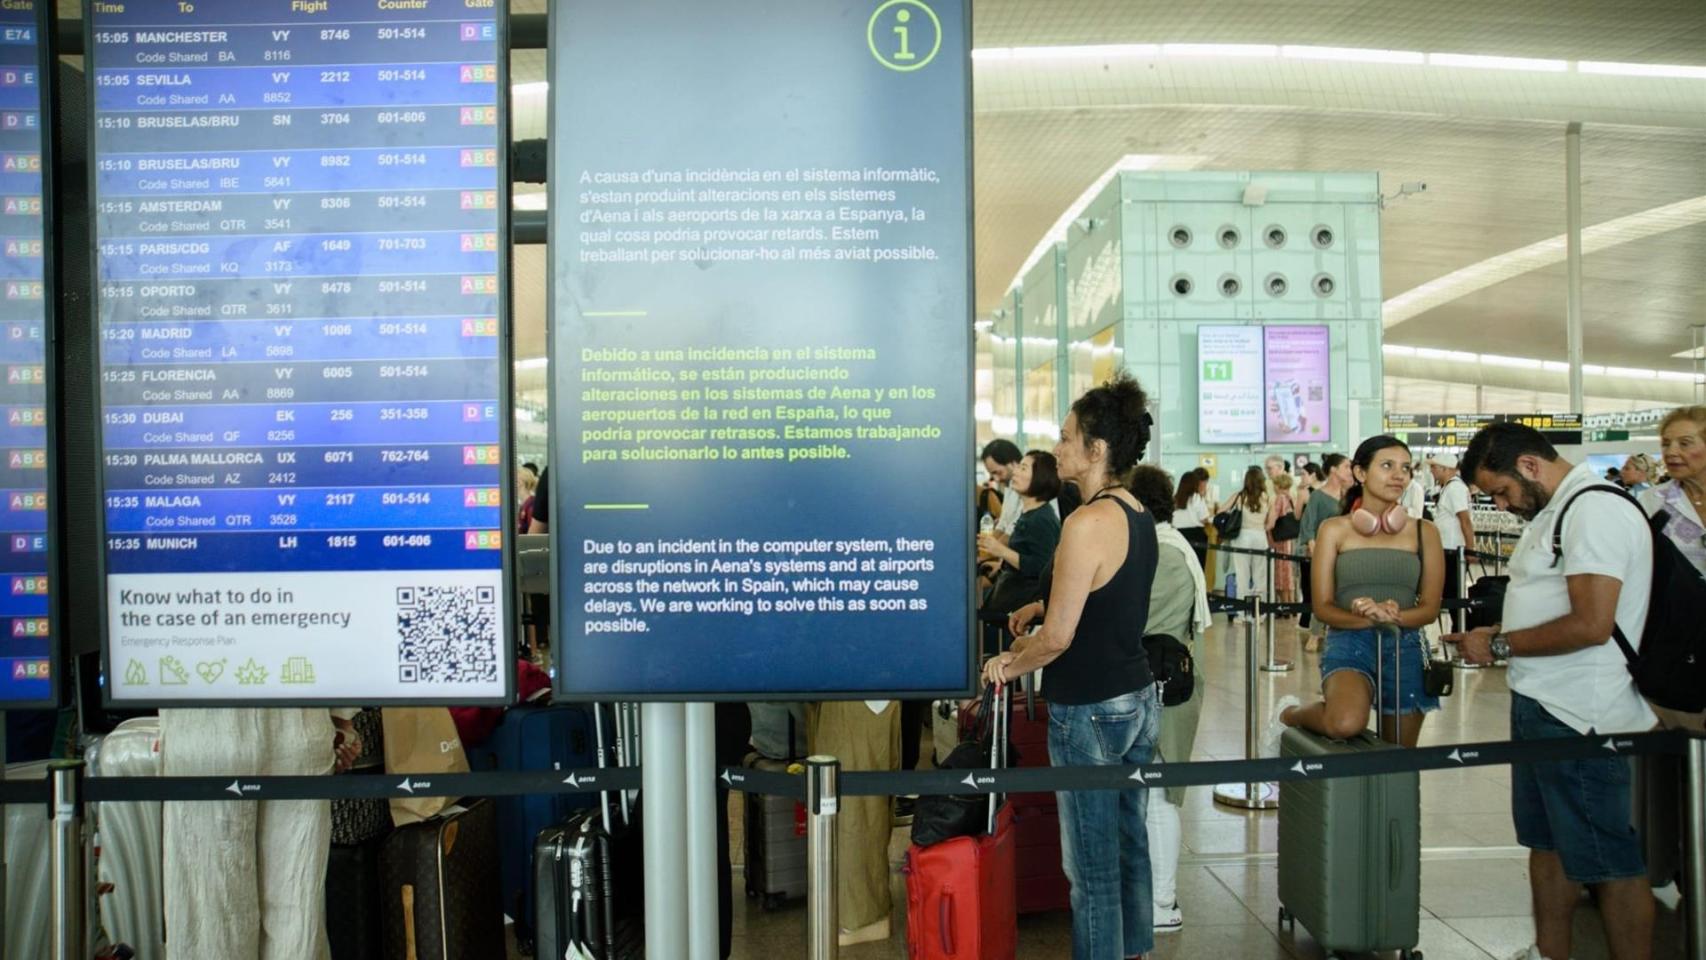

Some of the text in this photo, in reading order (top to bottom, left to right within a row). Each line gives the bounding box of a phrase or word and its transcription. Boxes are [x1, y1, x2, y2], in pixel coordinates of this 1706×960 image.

[94, 0, 494, 14] Time To Flight Counter Gate
[95, 30, 290, 44] 15:05 MANCHESTER VY
[96, 70, 426, 86] 15:05 SEVILLA VY 2212 501-514
[97, 114, 291, 129] 15:10 BRUSELAS/BRU SN
[97, 157, 240, 172] 15:10 BRUSELAS/BRU
[579, 167, 940, 184] A causa d'una incidència en el sistema informàtic,
[99, 200, 222, 214] 15:15 AMSTERDAM
[100, 243, 210, 256] 15:15 PARIS/CDG
[101, 283, 196, 299] 15:15 OPORTO
[101, 326, 193, 341] 15:20 MADRID
[581, 345, 876, 362] Debido a una incidencia en el sistema
[102, 369, 216, 383] 15:25 FLORENCIA
[581, 366, 850, 383] informático, se están produciendo
[1206, 362, 1228, 380] T1
[581, 384, 936, 403] alteraciones en los sistemas de Aena y en los
[104, 411, 184, 424] 15:30 DUBAI
[582, 404, 892, 424] aeropuertos de la red en España, lo que
[582, 424, 941, 444] podría provocar retrasos. Estamos trabajando
[106, 450, 430, 466] 15:30 PALMA MALLORCA UX 6071 762-764
[582, 444, 851, 464] para solucionarlo lo antes posible.
[106, 492, 431, 508] 15:35 MALAGA VY 2117 501-514
[108, 534, 432, 550] 15:35 MUNICH LH 1815 601-606
[584, 537, 934, 556] Due to an incident in the computer system, there
[584, 557, 934, 576] are disruptions in Aena's systems and at airports
[584, 577, 919, 596] across the network in Spain, which may cause
[120, 587, 294, 605] Know what to do in
[584, 596, 928, 616] delays. We are working to solve this as soon as
[120, 609, 351, 629] the case of an emergency
[585, 618, 650, 635] possible.
[120, 634, 236, 648] Emergency Response Plan
